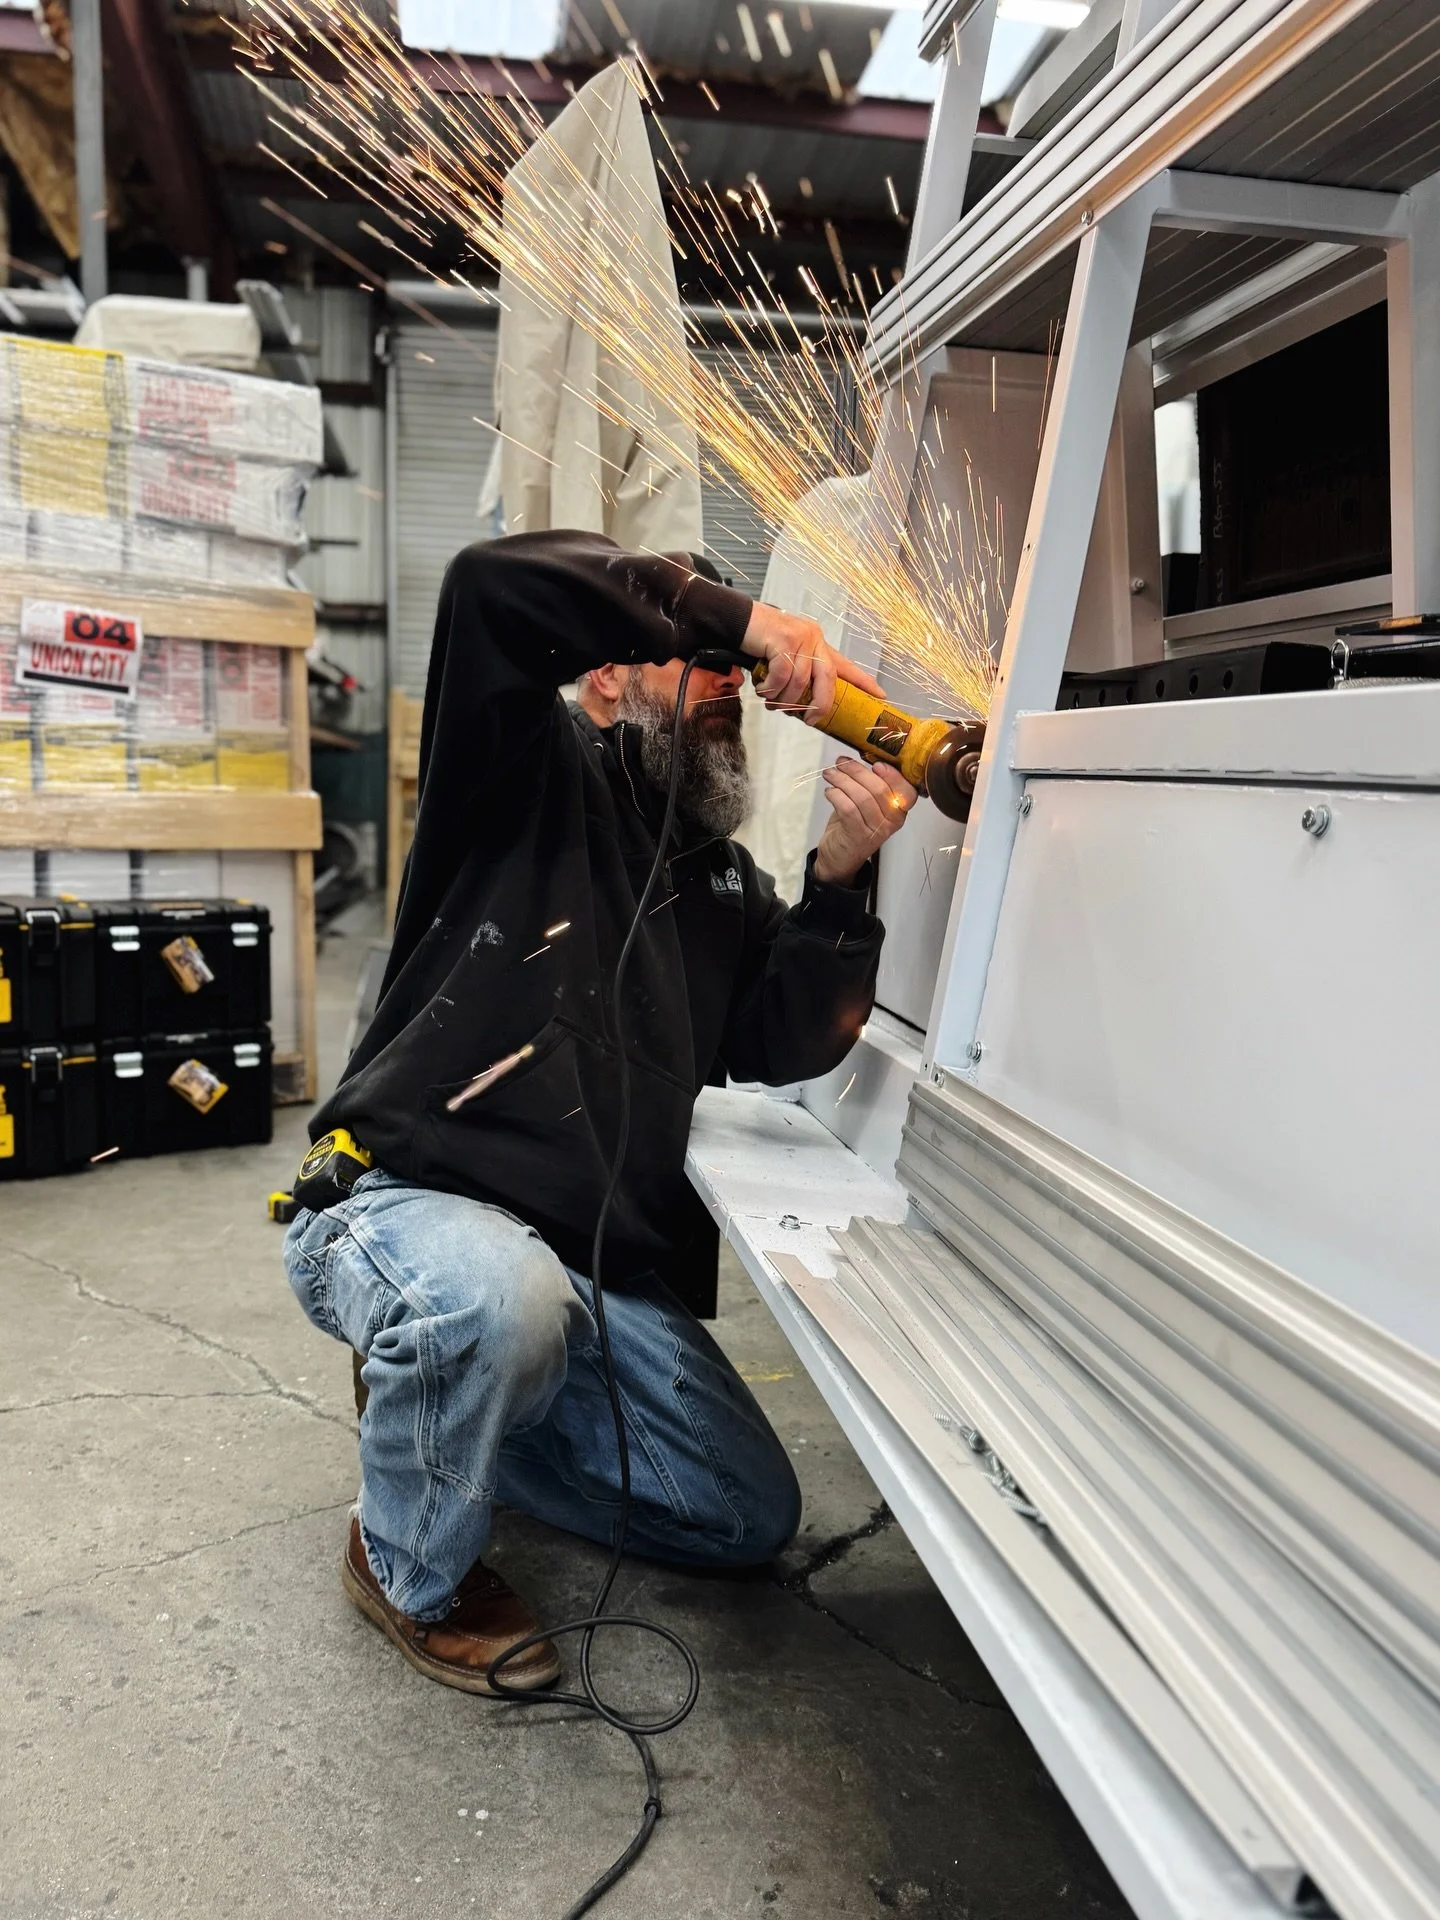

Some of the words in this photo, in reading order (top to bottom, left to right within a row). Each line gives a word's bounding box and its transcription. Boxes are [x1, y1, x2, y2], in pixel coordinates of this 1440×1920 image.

[72, 613, 131, 646] 04
[31, 641, 86, 676] UNION
[89, 651, 128, 684] CITY
